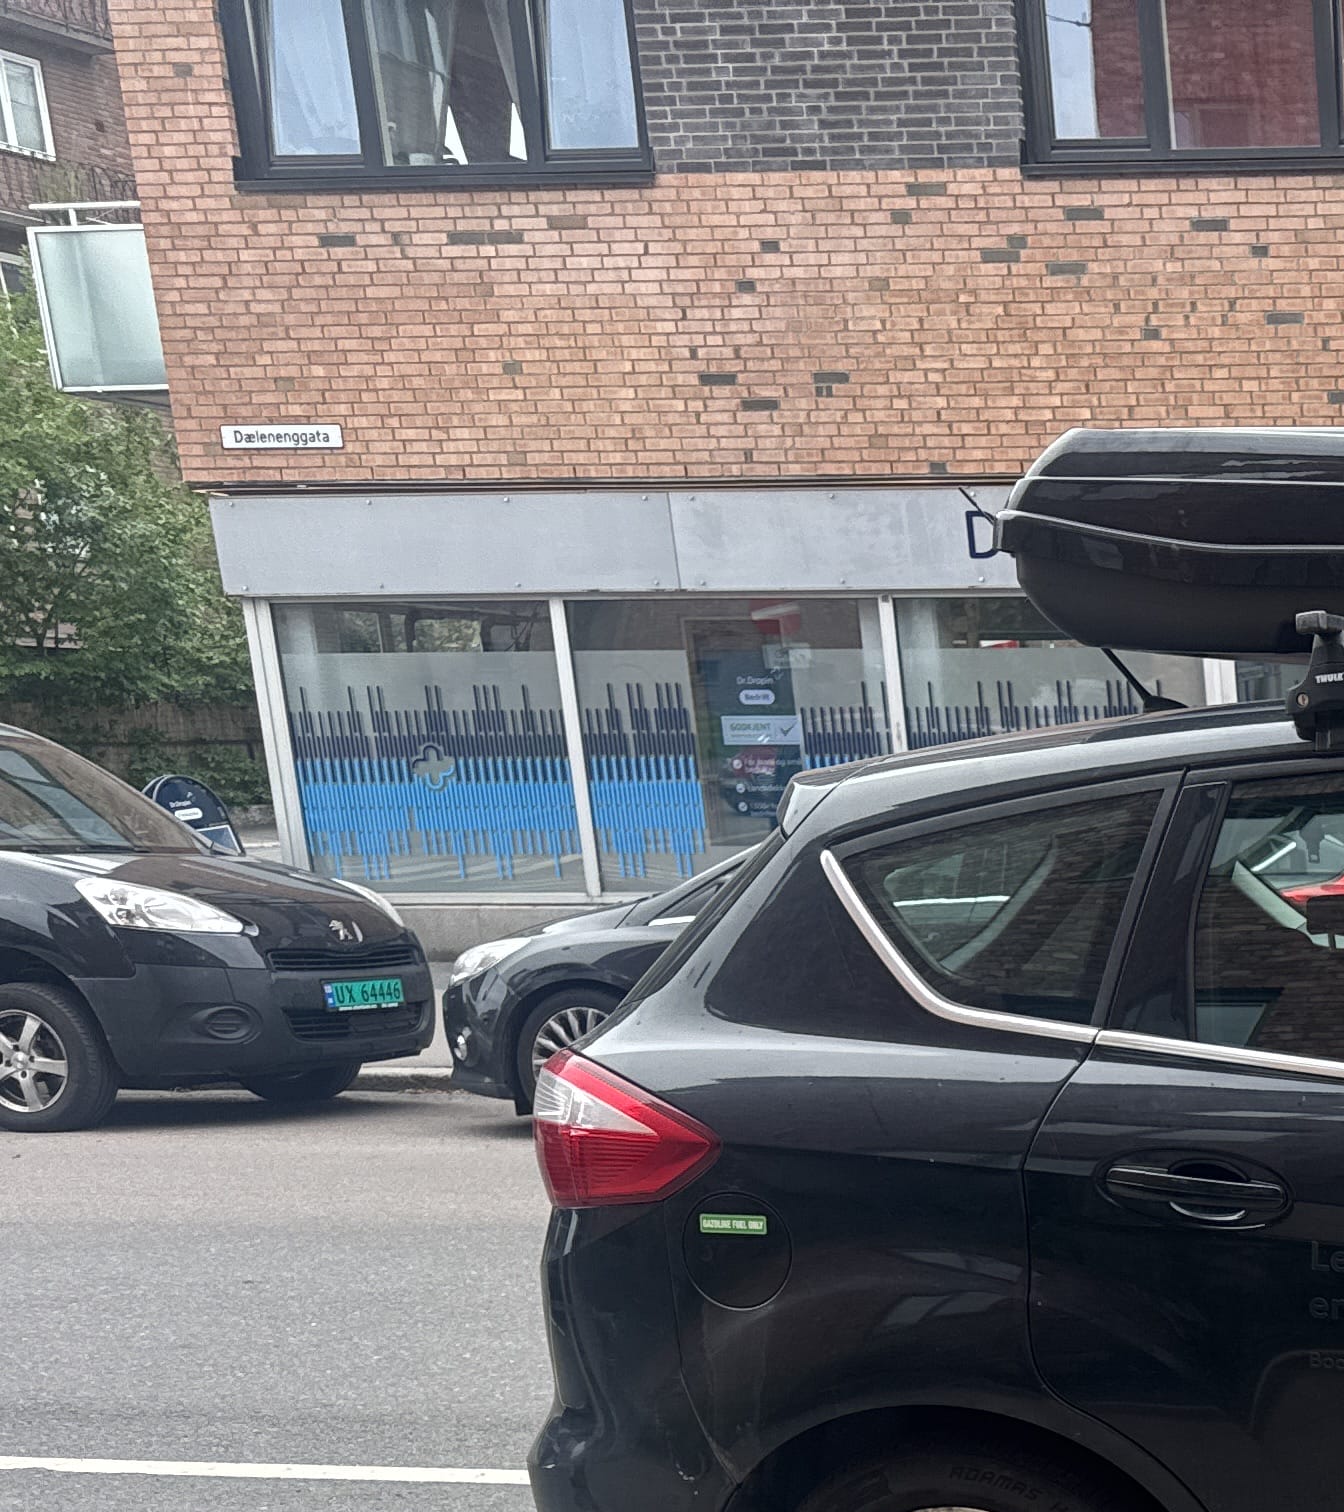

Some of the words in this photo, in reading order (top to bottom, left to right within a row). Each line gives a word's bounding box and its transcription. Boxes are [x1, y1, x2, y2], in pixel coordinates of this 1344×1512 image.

[233, 430, 330, 446] Dælenenggata
[1315, 672, 1344, 684] THULE
[334, 985, 356, 1004] UX
[361, 982, 401, 1003] 64446
[949, 1466, 1043, 1501] ADAMAS
